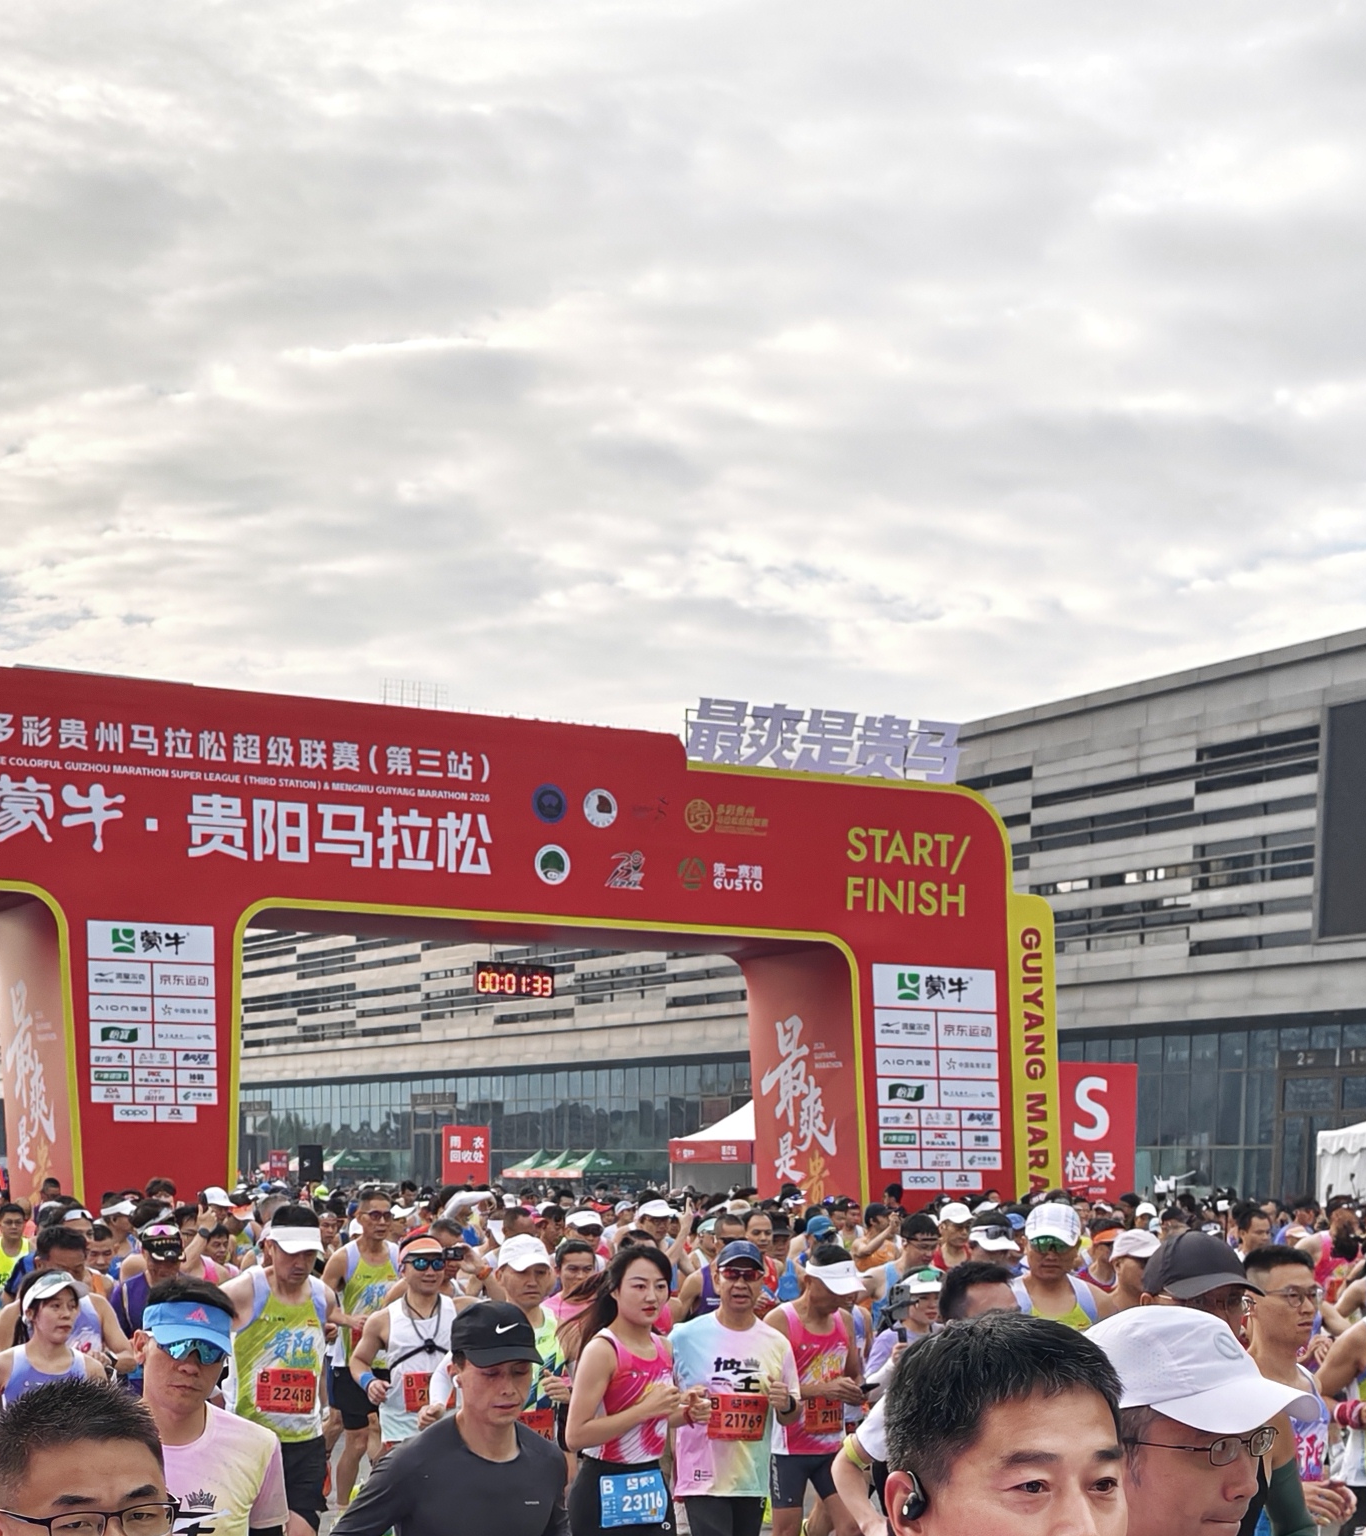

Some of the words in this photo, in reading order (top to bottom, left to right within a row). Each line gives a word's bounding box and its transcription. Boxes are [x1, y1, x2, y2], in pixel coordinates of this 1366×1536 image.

[688, 697, 969, 784] 最爽是贵马
[9, 757, 63, 769] COLORFUL
[65, 762, 112, 773] GUIZHOU
[113, 765, 170, 778] MARATHON
[171, 769, 202, 781] SUPER
[203, 772, 241, 783] LEAGUE
[331, 782, 375, 793] MENGNIU
[376, 786, 416, 797] GUIYANG
[417, 789, 468, 800] MARATHON
[470, 792, 490, 802] 2026
[846, 827, 971, 875] START/
[713, 878, 763, 891] GUSTO
[845, 876, 967, 917] FINISH
[140, 930, 186, 956] 蒙牛
[159, 974, 210, 987] 京东运动
[477, 971, 553, 997] 00:01:33
[925, 974, 970, 1003] 蒙牛
[1019, 927, 1047, 1081] GUIYANG
[943, 1024, 993, 1038] 京东运动
[1073, 1075, 1111, 1142] S
[449, 1149, 485, 1164] 回收处
[1065, 1150, 1117, 1183] 检录
[260, 1371, 270, 1384] B
[406, 1374, 414, 1388] B
[273, 1387, 311, 1401] 22418
[710, 1397, 720, 1410] B
[724, 1412, 762, 1428] 21769
[602, 1479, 614, 1495] B
[622, 1491, 664, 1512] 23116
